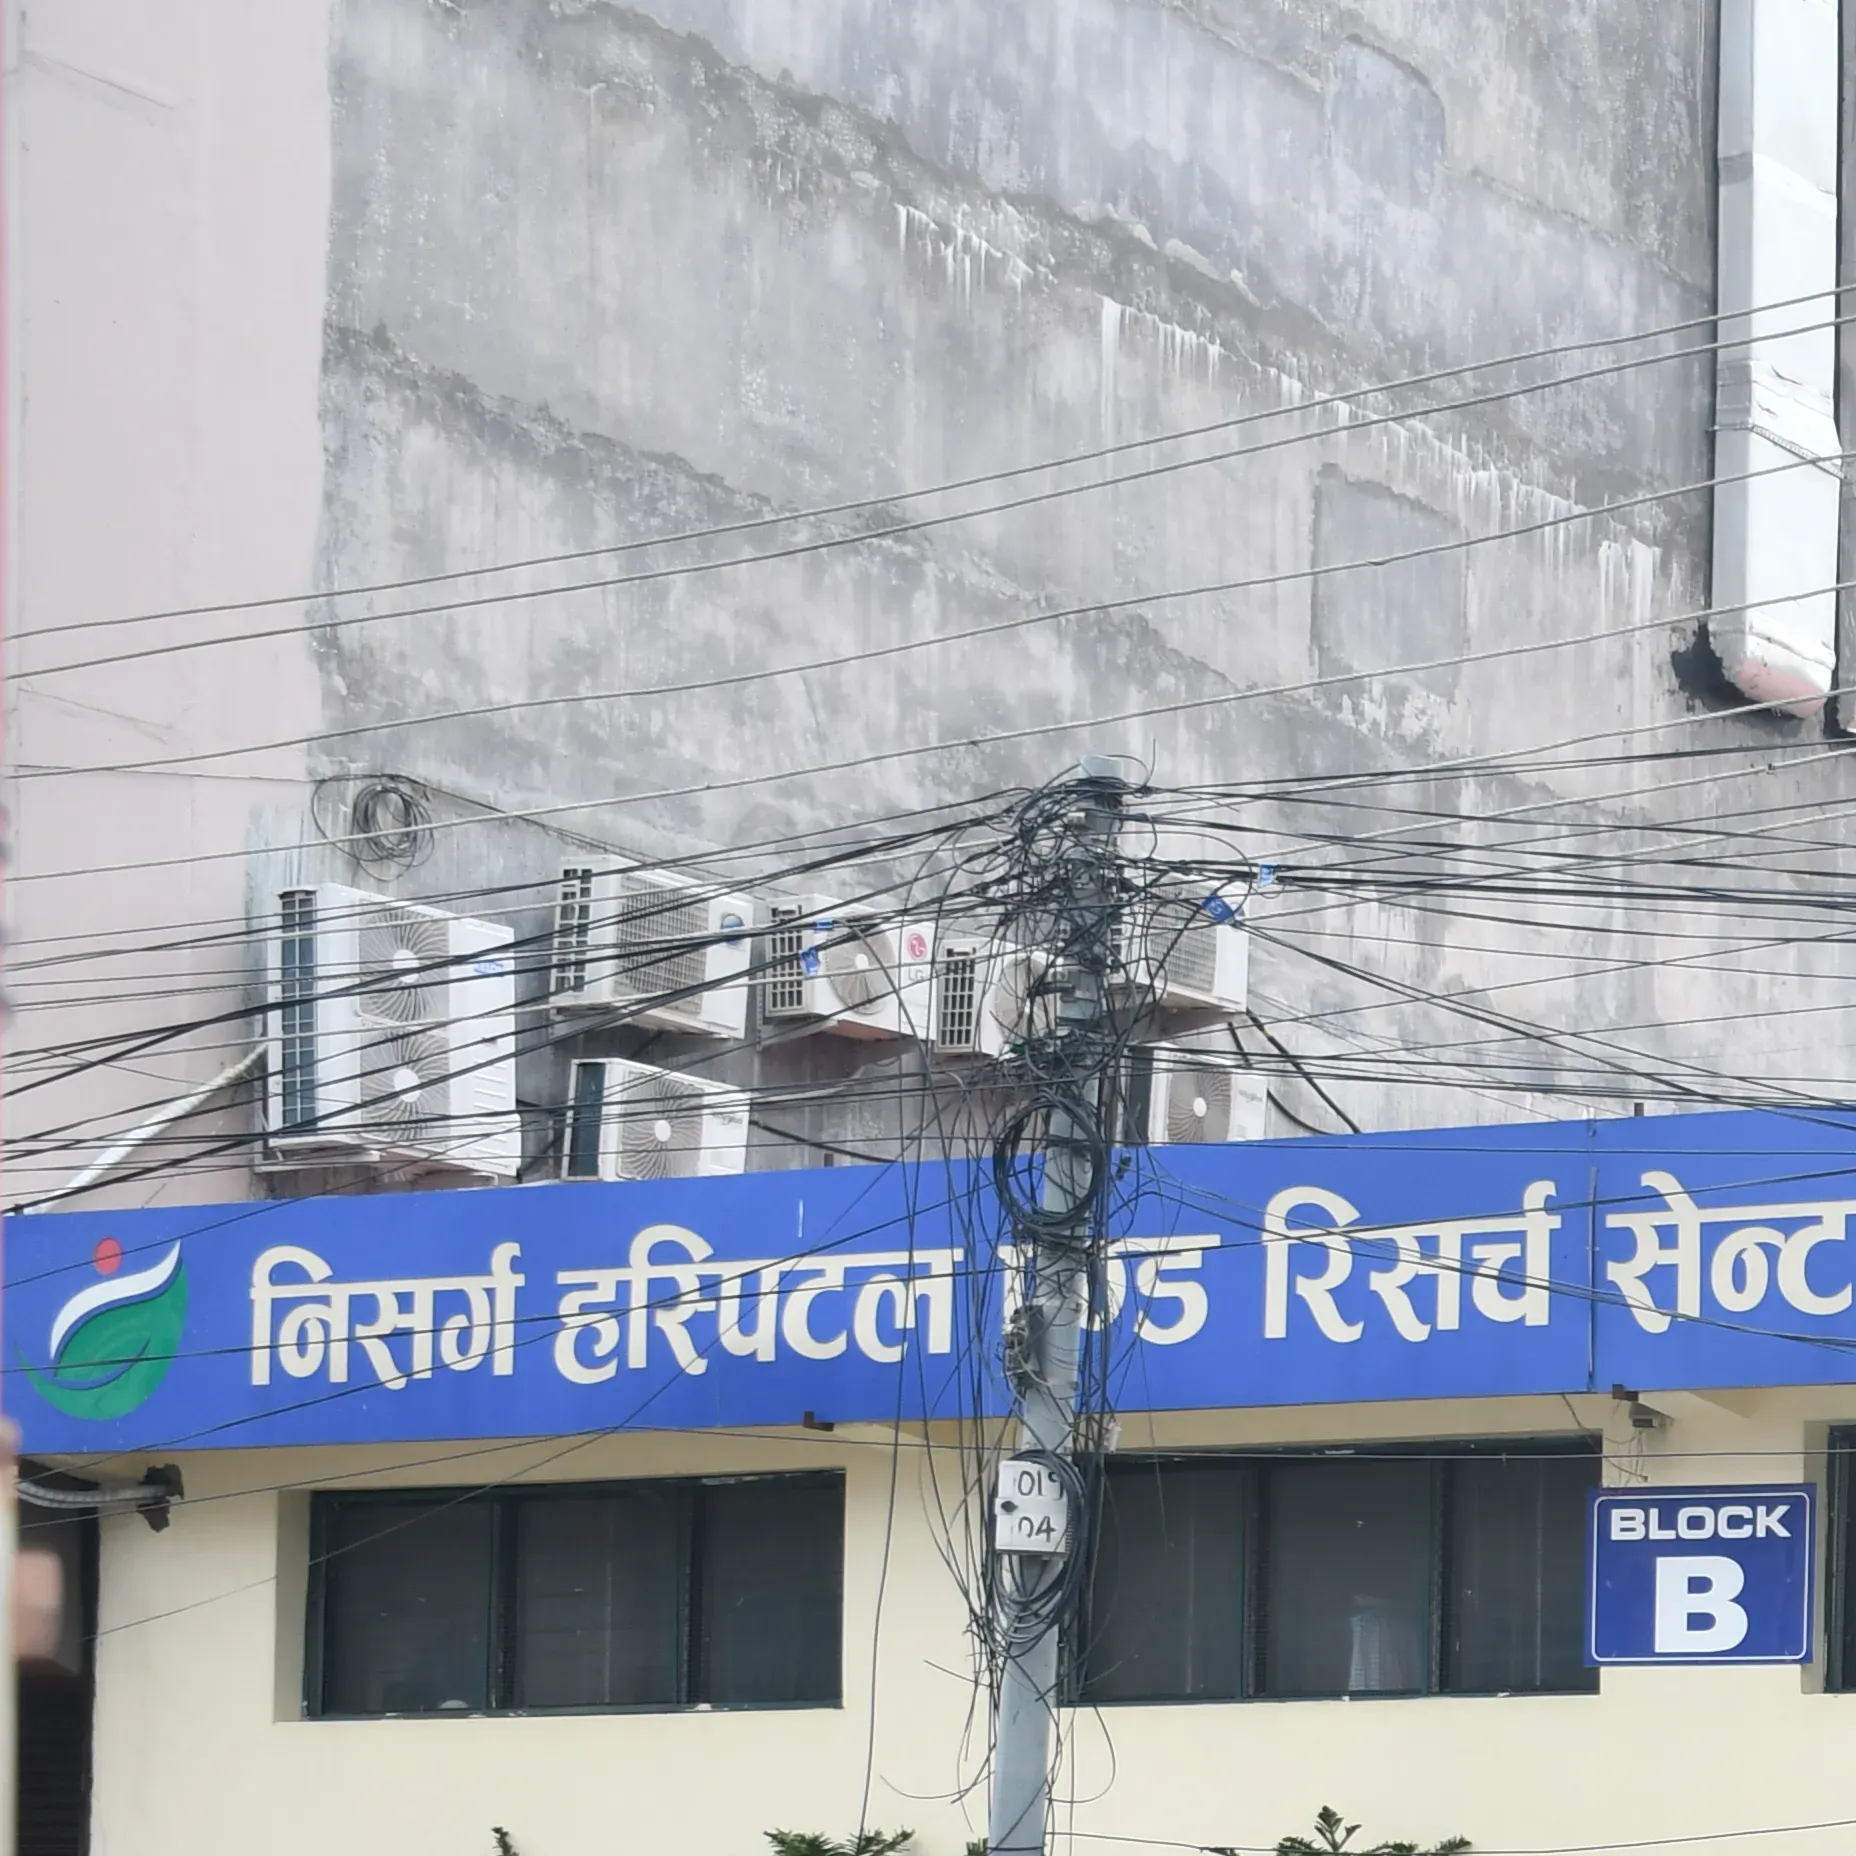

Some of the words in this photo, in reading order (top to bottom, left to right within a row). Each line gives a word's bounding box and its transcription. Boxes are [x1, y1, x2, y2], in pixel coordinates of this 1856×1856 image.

[249, 1240, 526, 1391] निसर्ग
[553, 1225, 965, 1384] हस्पिटल
[1261, 1180, 1562, 1343] रिसर्च
[1608, 1505, 1792, 1541] BLOCK
[1654, 1556, 1749, 1655] B
